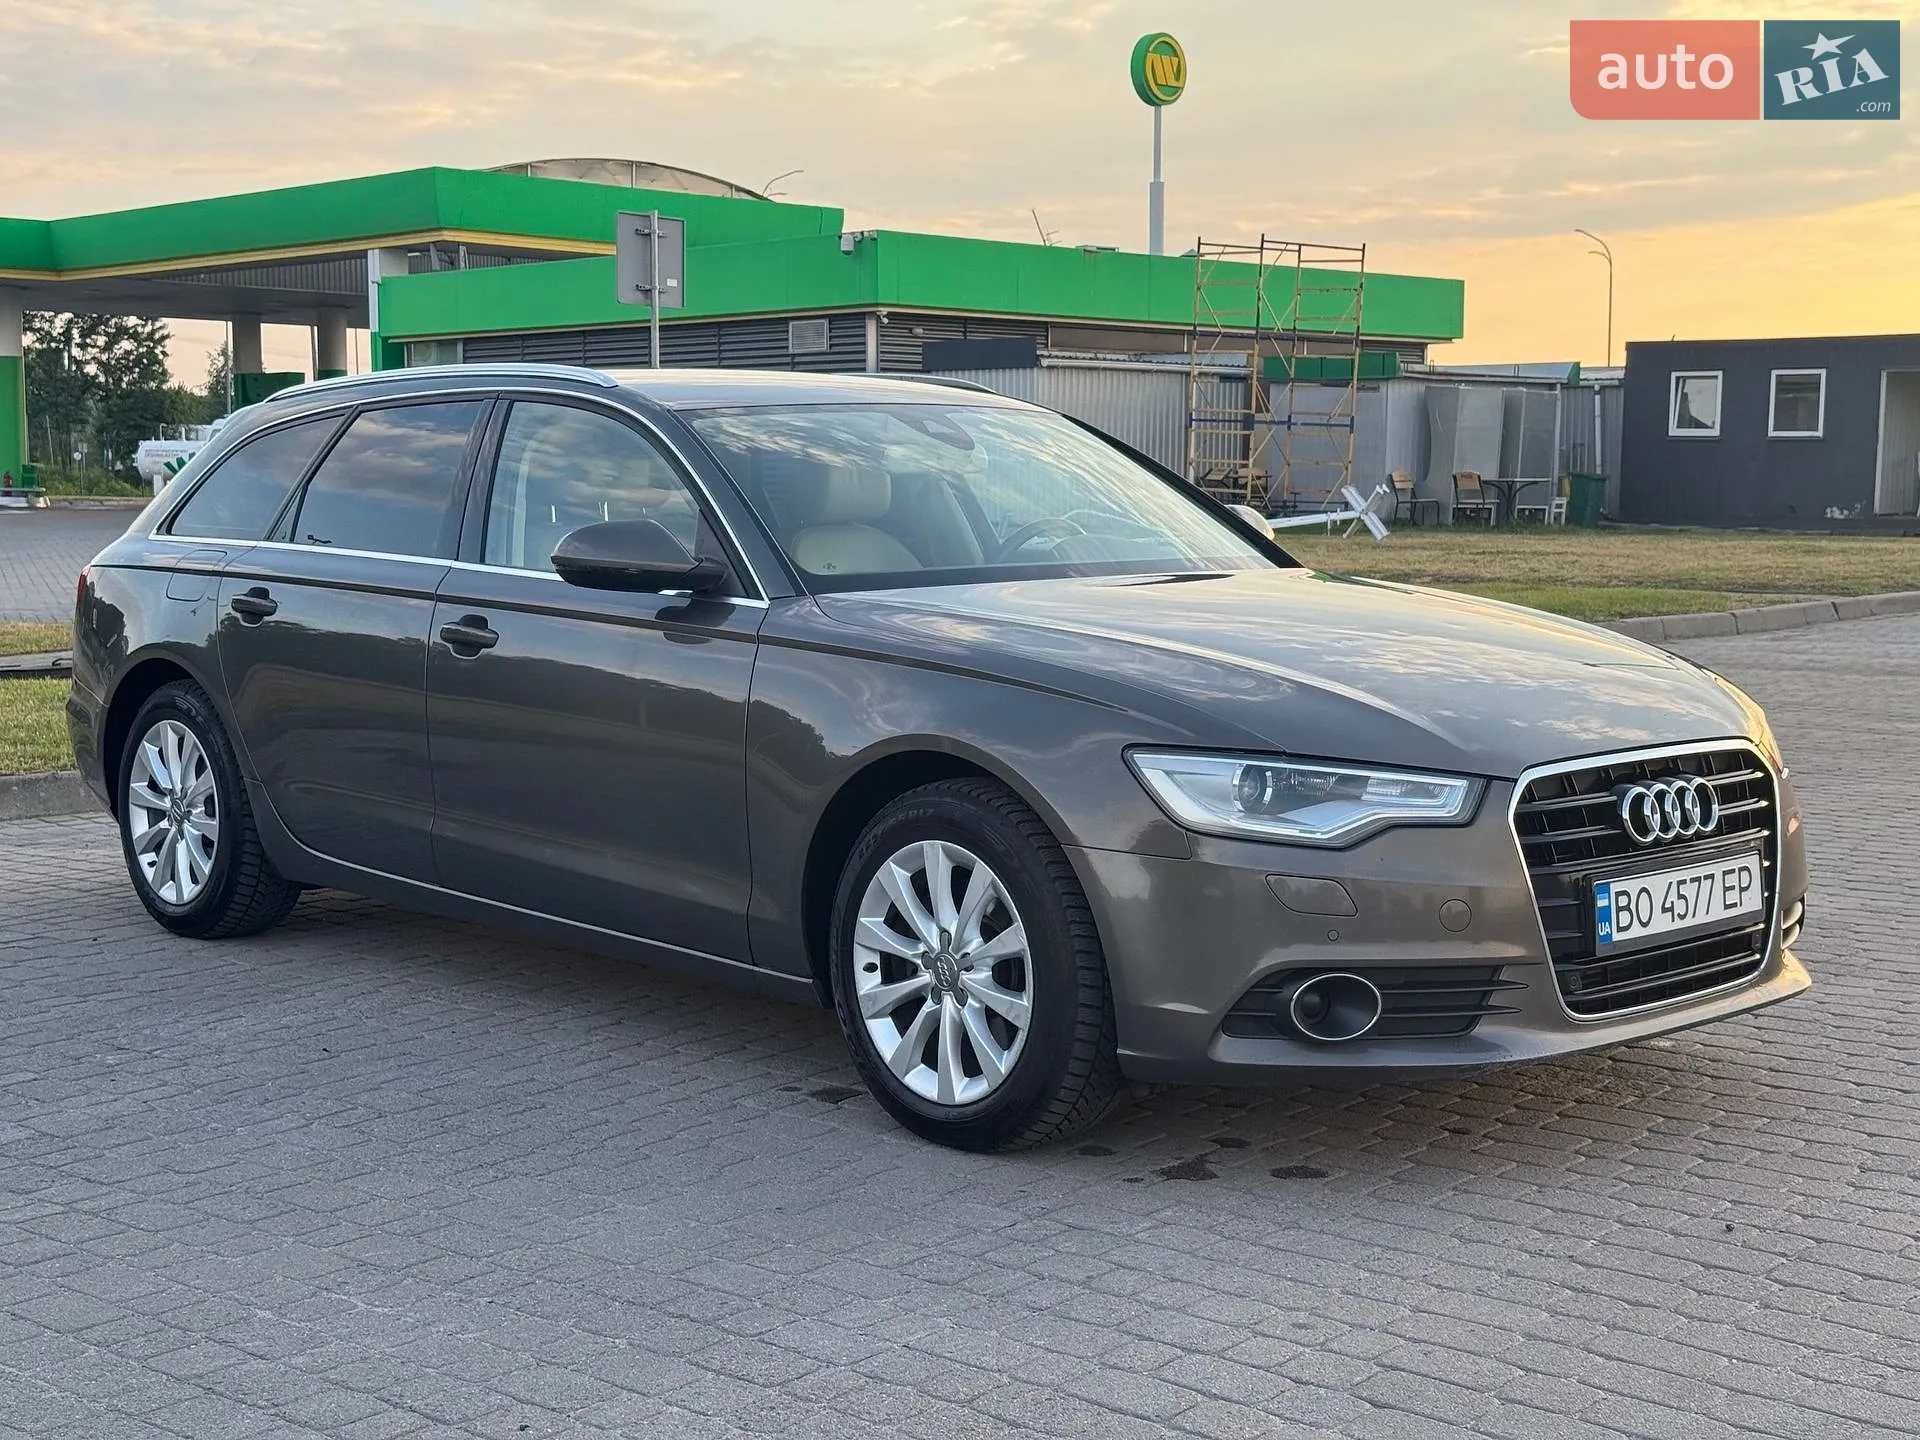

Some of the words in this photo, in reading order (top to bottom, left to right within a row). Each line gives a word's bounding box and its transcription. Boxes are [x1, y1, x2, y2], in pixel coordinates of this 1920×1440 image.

[1614, 886, 1653, 933] BO
[1661, 873, 1715, 923] 4577
[1722, 865, 1753, 911] EP
[1598, 922, 1611, 936] UA
